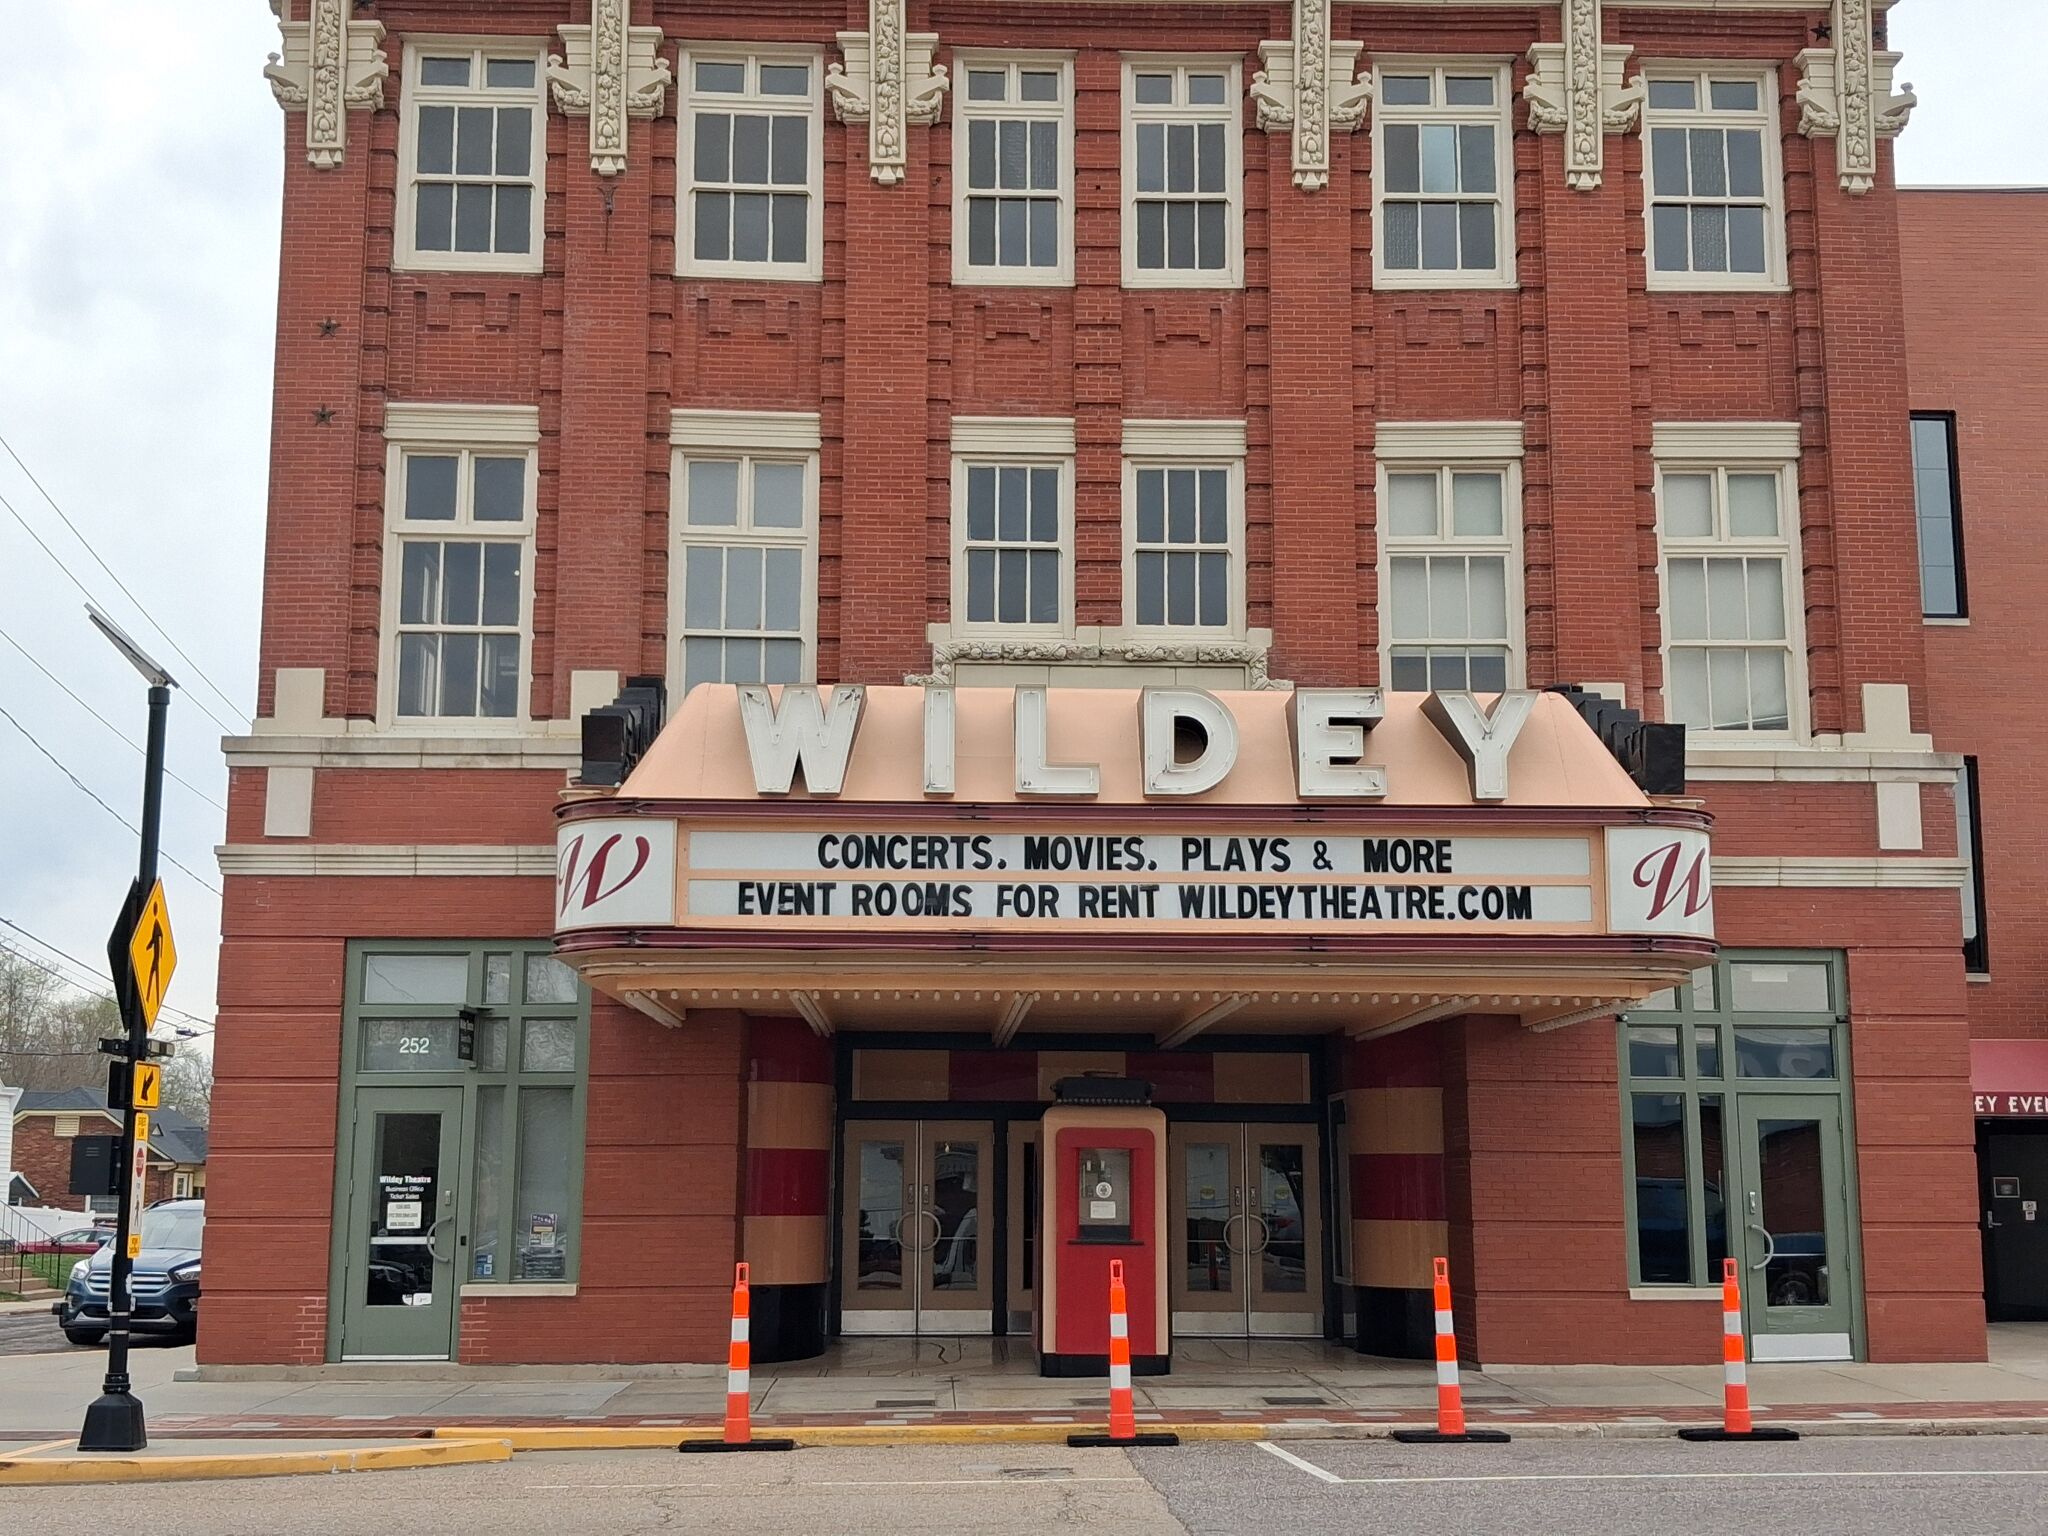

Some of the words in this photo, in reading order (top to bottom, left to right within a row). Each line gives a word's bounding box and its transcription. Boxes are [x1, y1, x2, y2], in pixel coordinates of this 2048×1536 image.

[736, 683, 1539, 801] WILDEY
[817, 833, 1008, 870] CONCERTS.
[1024, 835, 1158, 872] MOVIES.
[1181, 837, 1291, 873] PLAYS
[1312, 840, 1334, 872] &
[1363, 839, 1453, 874] MORE
[738, 881, 836, 916] EVENT
[852, 882, 973, 917] ROOMS
[996, 884, 1060, 918] FOR
[1078, 884, 1160, 918] RENT
[1179, 884, 1533, 921] WILDEYTHEATRE.COM
[400, 1037, 430, 1054] 252
[379, 1175, 403, 1184] Wildey
